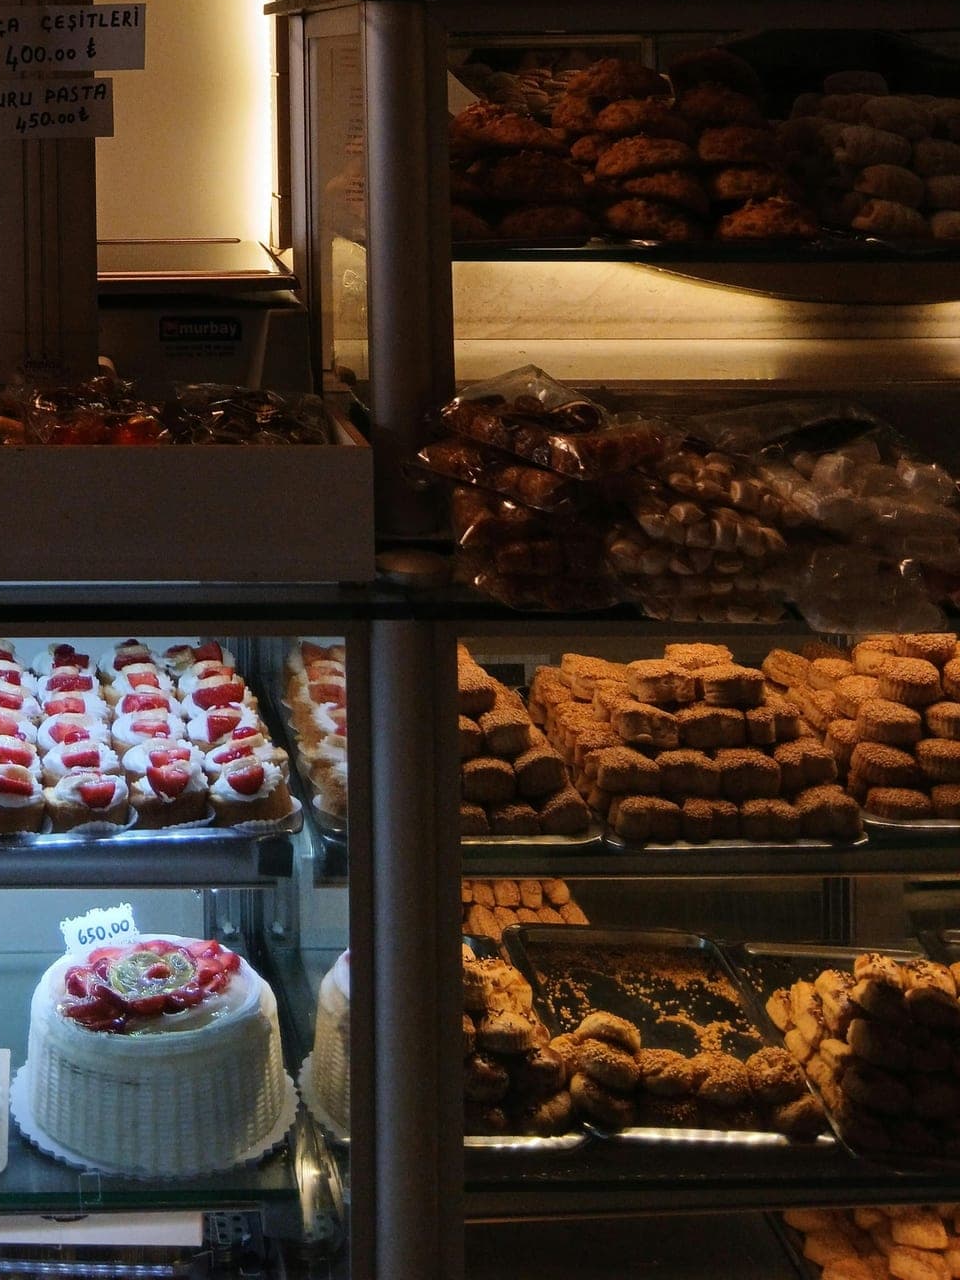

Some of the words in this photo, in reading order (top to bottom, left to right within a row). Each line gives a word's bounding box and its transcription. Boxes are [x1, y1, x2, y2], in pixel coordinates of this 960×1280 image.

[40, 6, 140, 33] ÇEŞİTLERİ
[5, 45, 77, 72] 400.00
[45, 83, 107, 105] PASTA
